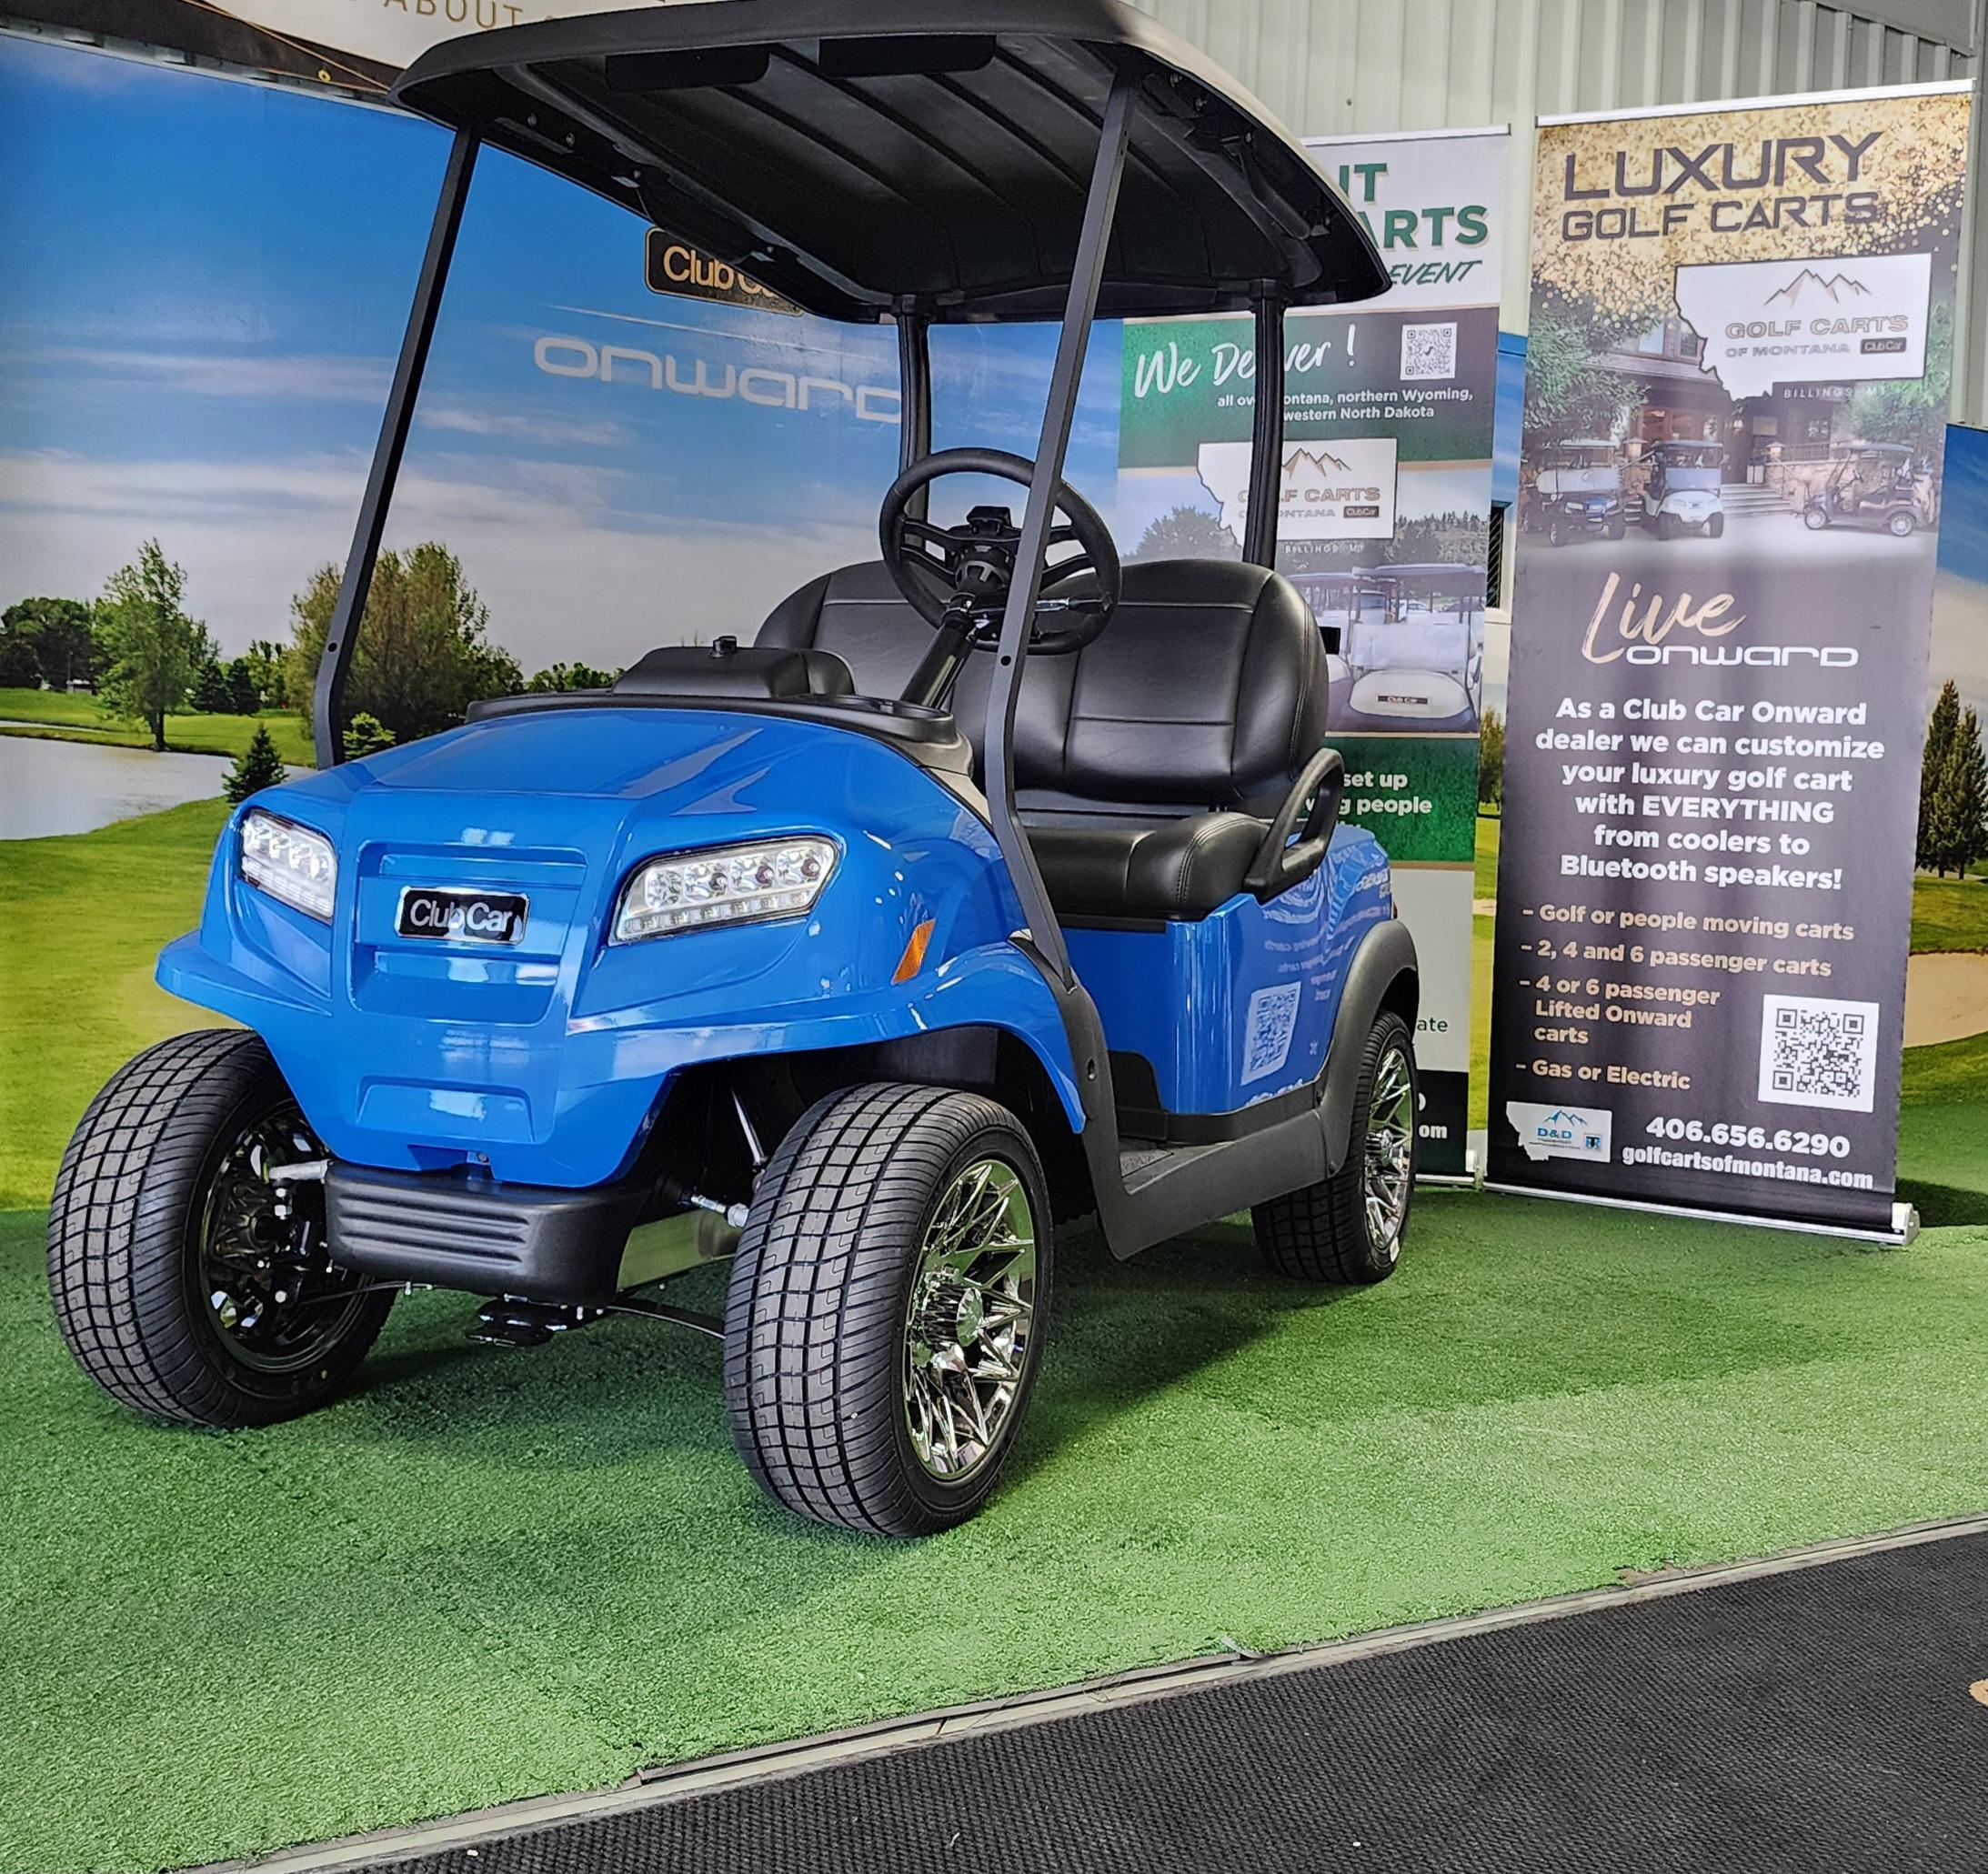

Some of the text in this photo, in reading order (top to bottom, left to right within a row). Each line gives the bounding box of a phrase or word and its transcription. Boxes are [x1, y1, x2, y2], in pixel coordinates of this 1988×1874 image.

[1564, 132, 1883, 201] LUXURY
[1562, 192, 1880, 242] GOLF CARTS
[1390, 260, 1482, 286] EVENT
[1725, 316, 1908, 339] GOLF CARTS
[1725, 347, 1748, 357] OF
[1752, 344, 1850, 356] MONTANA
[1134, 341, 1201, 398] We
[1217, 387, 1474, 407] all ov ontana, northern Wyoming,
[1783, 386, 1852, 399] BILLINGS
[1283, 406, 1435, 422] western North Dakota
[1304, 487, 1381, 502] CARTS
[1581, 571, 1747, 664] Live
[1556, 697, 1867, 726] As a Club Car Onward
[1535, 728, 1885, 759] dealer we can customize
[1380, 774, 1408, 791] up
[1561, 762, 1852, 792] your luxury golf cart
[1357, 797, 1432, 816] people
[1575, 793, 1834, 824] with EVERYTHING
[1594, 824, 1810, 856] from coolers to
[1561, 856, 1842, 890] Bluetooth speakers!
[1539, 905, 1585, 924] Golf
[1591, 909, 1614, 926] or
[1620, 908, 1697, 931] people
[1702, 914, 1789, 939] moving
[1795, 920, 1854, 941] carts
[1538, 940, 1557, 959] 2,
[1562, 941, 1577, 958] 4
[1582, 944, 1624, 963] and
[1629, 946, 1644, 963] 6
[1650, 950, 1767, 975] passenger
[1772, 957, 1832, 977] carts
[1535, 976, 1551, 993] 4
[1556, 978, 1580, 995] or
[1585, 977, 1600, 995] 6
[1604, 981, 1721, 1006] passenger
[1536, 1000, 1692, 1028] Lifted Onward
[1533, 1024, 1590, 1045] carts
[1532, 1060, 1572, 1078] Gas
[1577, 1066, 1601, 1082] or
[1607, 1065, 1691, 1090] Electric
[1537, 1127, 1572, 1138] D&D
[1645, 1117, 1851, 1158] 406.656.6290
[1622, 1146, 1873, 1189] golfcartsofmontana.com
